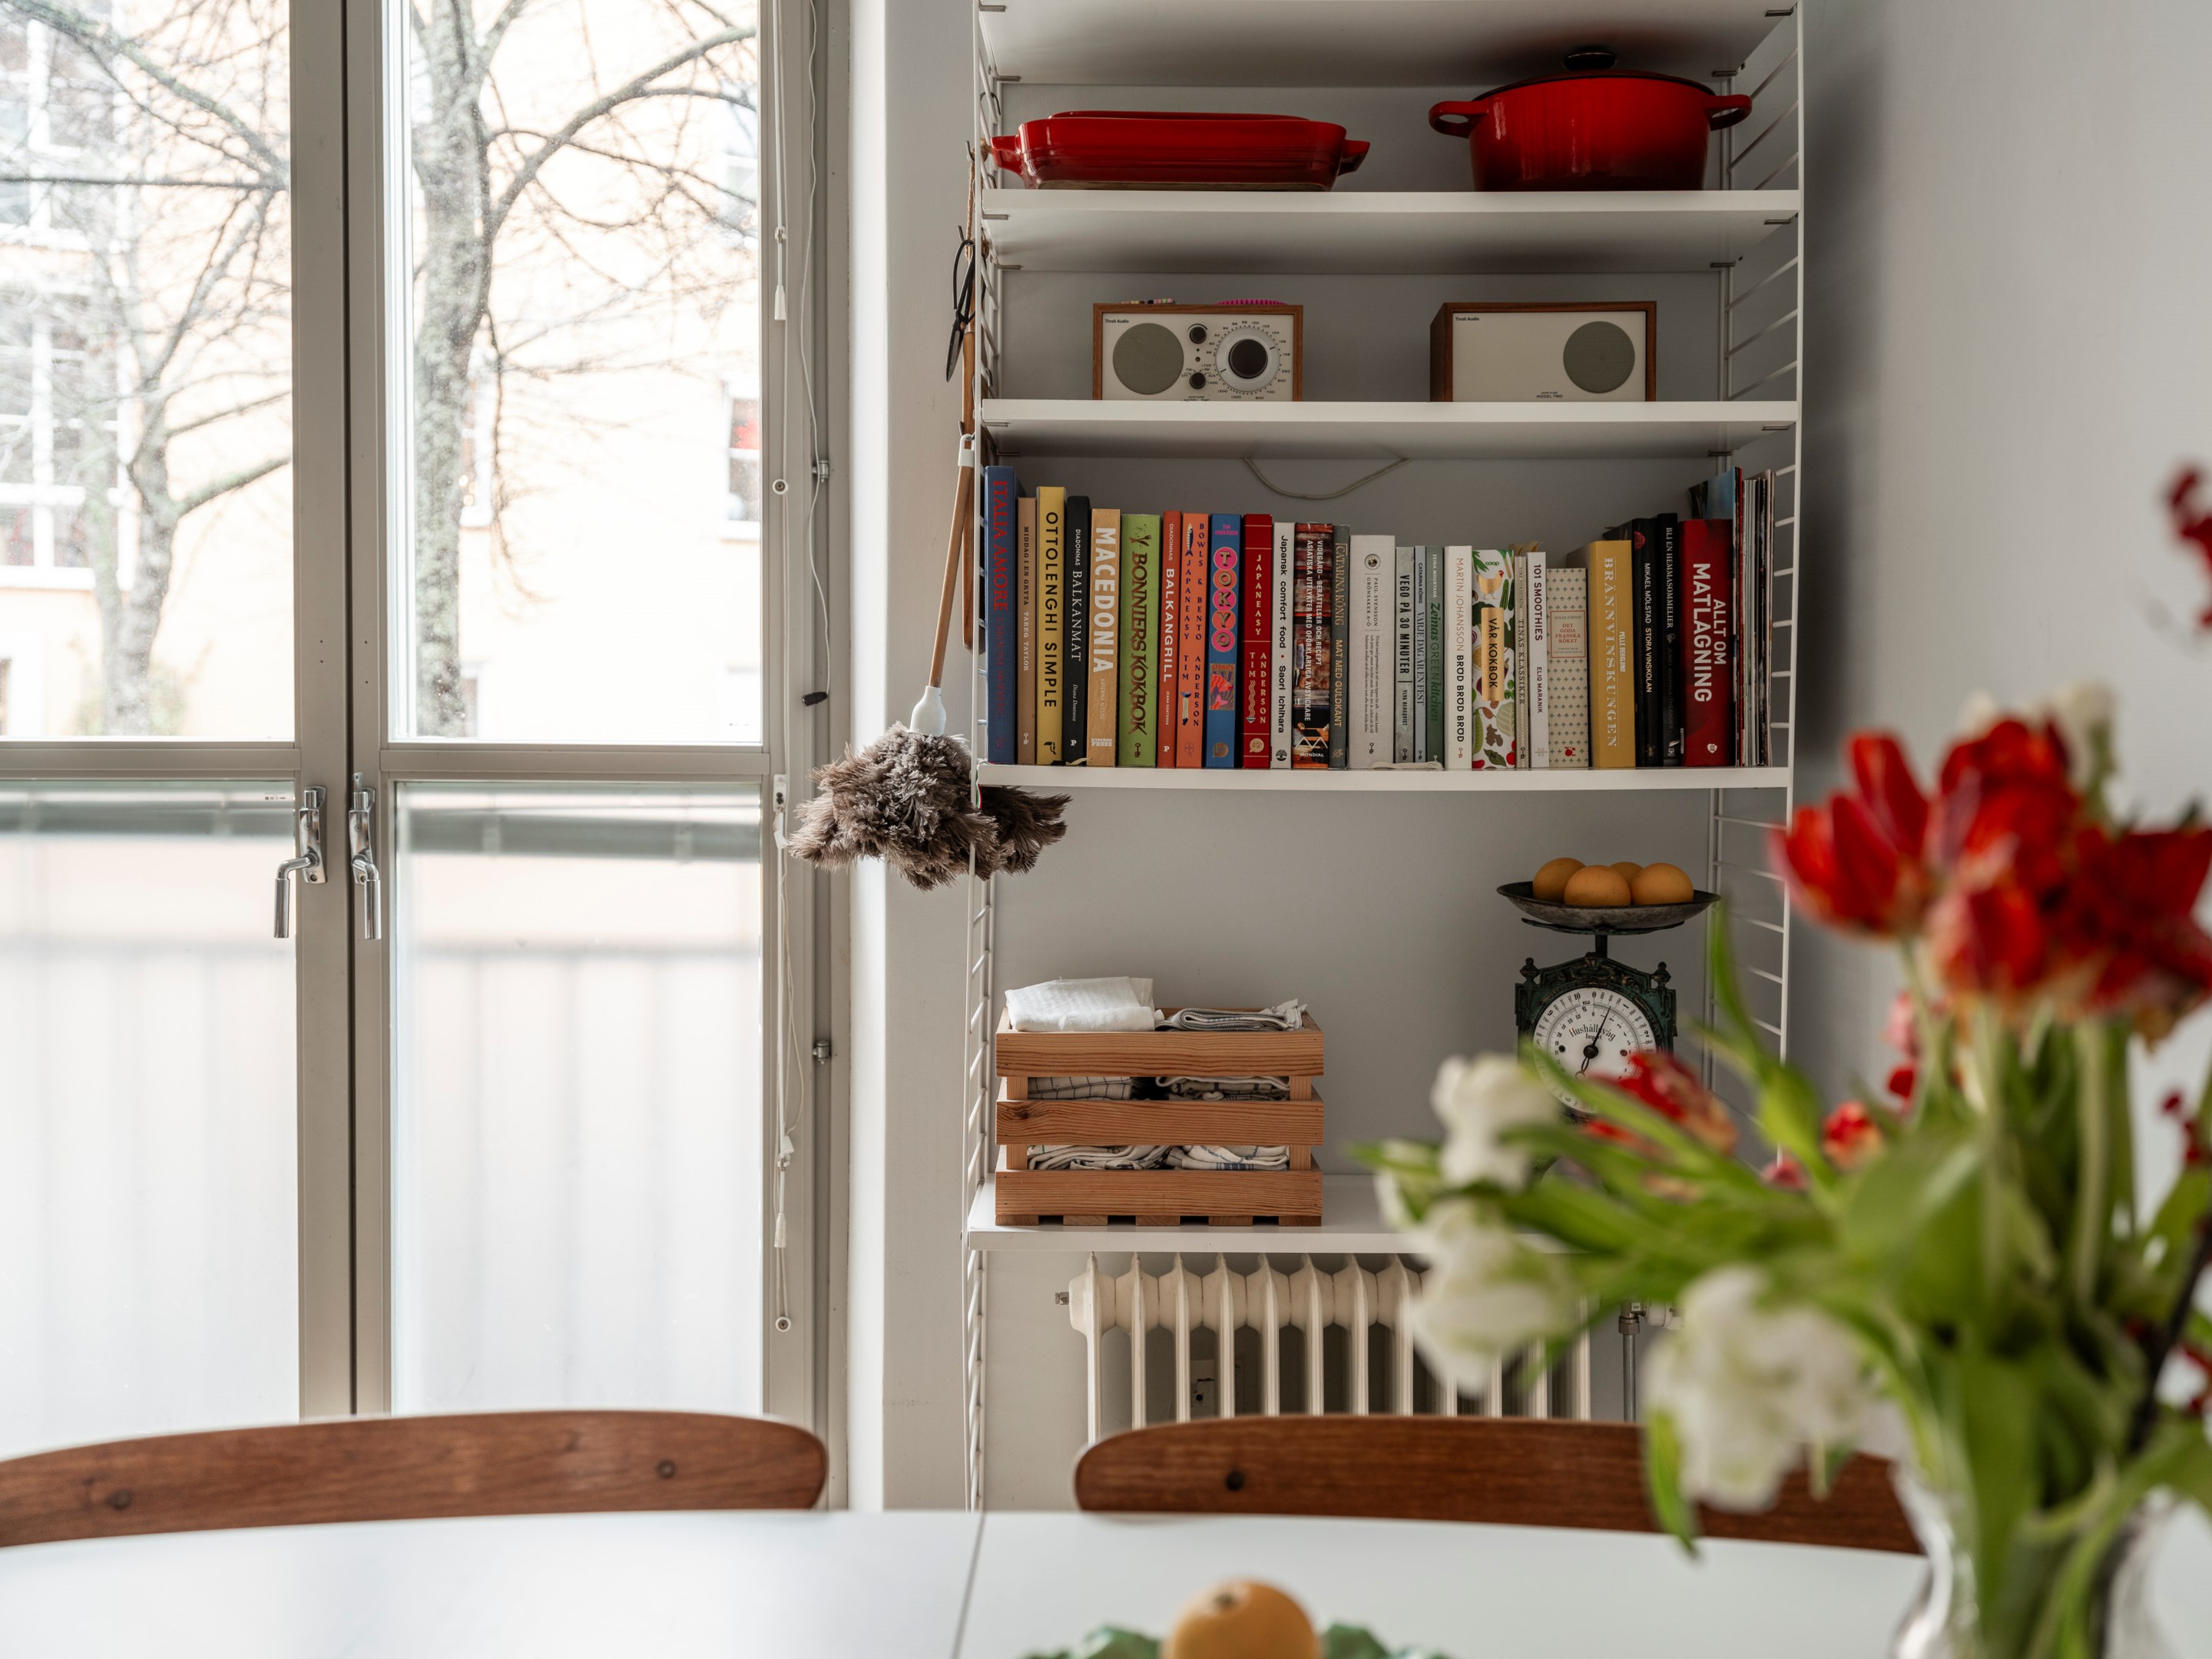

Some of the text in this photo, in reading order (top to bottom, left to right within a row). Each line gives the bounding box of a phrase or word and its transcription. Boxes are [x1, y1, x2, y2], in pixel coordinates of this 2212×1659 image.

[993, 479, 1008, 540] ITALIA
[1197, 522, 1206, 567] BOWLS
[1306, 540, 1314, 575] ASIATISKA
[1666, 541, 1673, 551] EN
[993, 543, 1008, 612] AMORE
[1024, 566, 1029, 577] EN
[1399, 575, 1410, 598] VEGO
[1455, 558, 1464, 591] MARTIN
[1533, 564, 1541, 578] 101
[1044, 512, 1059, 707] OTTOLENGHI SIMPLE
[1071, 570, 1083, 661] BALKANMAT
[1093, 527, 1117, 674] MACEDONIA
[1216, 551, 1232, 647] TOKYO
[1305, 578, 1313, 612] UTFLYKTER
[1316, 581, 1324, 624] BERÄTTELSER
[1399, 602, 1412, 614] PÅ
[1533, 582, 1543, 641] SMOOTHIES
[1163, 568, 1175, 683] BALKANGRILL
[1277, 535, 1289, 733] Japansk comfort food Saori Ichihara
[1305, 613, 1313, 628] MED
[1333, 545, 1346, 727] CATARINA KÖNIG MAT MED GULDKANT
[1399, 618, 1410, 629] 30
[1416, 611, 1425, 637] VARJE
[1430, 602, 1441, 641] Zeinas
[1455, 593, 1464, 651] JOHANSSON
[1693, 563, 1713, 702] MATLAGNING
[1713, 598, 1727, 664] ALLT OM
[1128, 551, 1149, 736] BONNIERS KOKBOK
[1399, 633, 1410, 674] MINUTER
[1416, 639, 1425, 657] DAG
[1430, 642, 1439, 680] GREEN
[1488, 618, 1500, 688] VÅR KOKBOK
[1604, 556, 1618, 747] BRÄNNVINSKUNGEN
[1416, 658, 1426, 671] ÄR
[1416, 671, 1425, 684] EN
[1193, 655, 1201, 727] ANDERSON
[1259, 651, 1267, 724] ANDERSON
[1416, 684, 1425, 707] FEST
[1430, 681, 1441, 722] kitchen
[1573, 992, 1581, 1001] 10
[1585, 1032, 1602, 1041] Imprt
